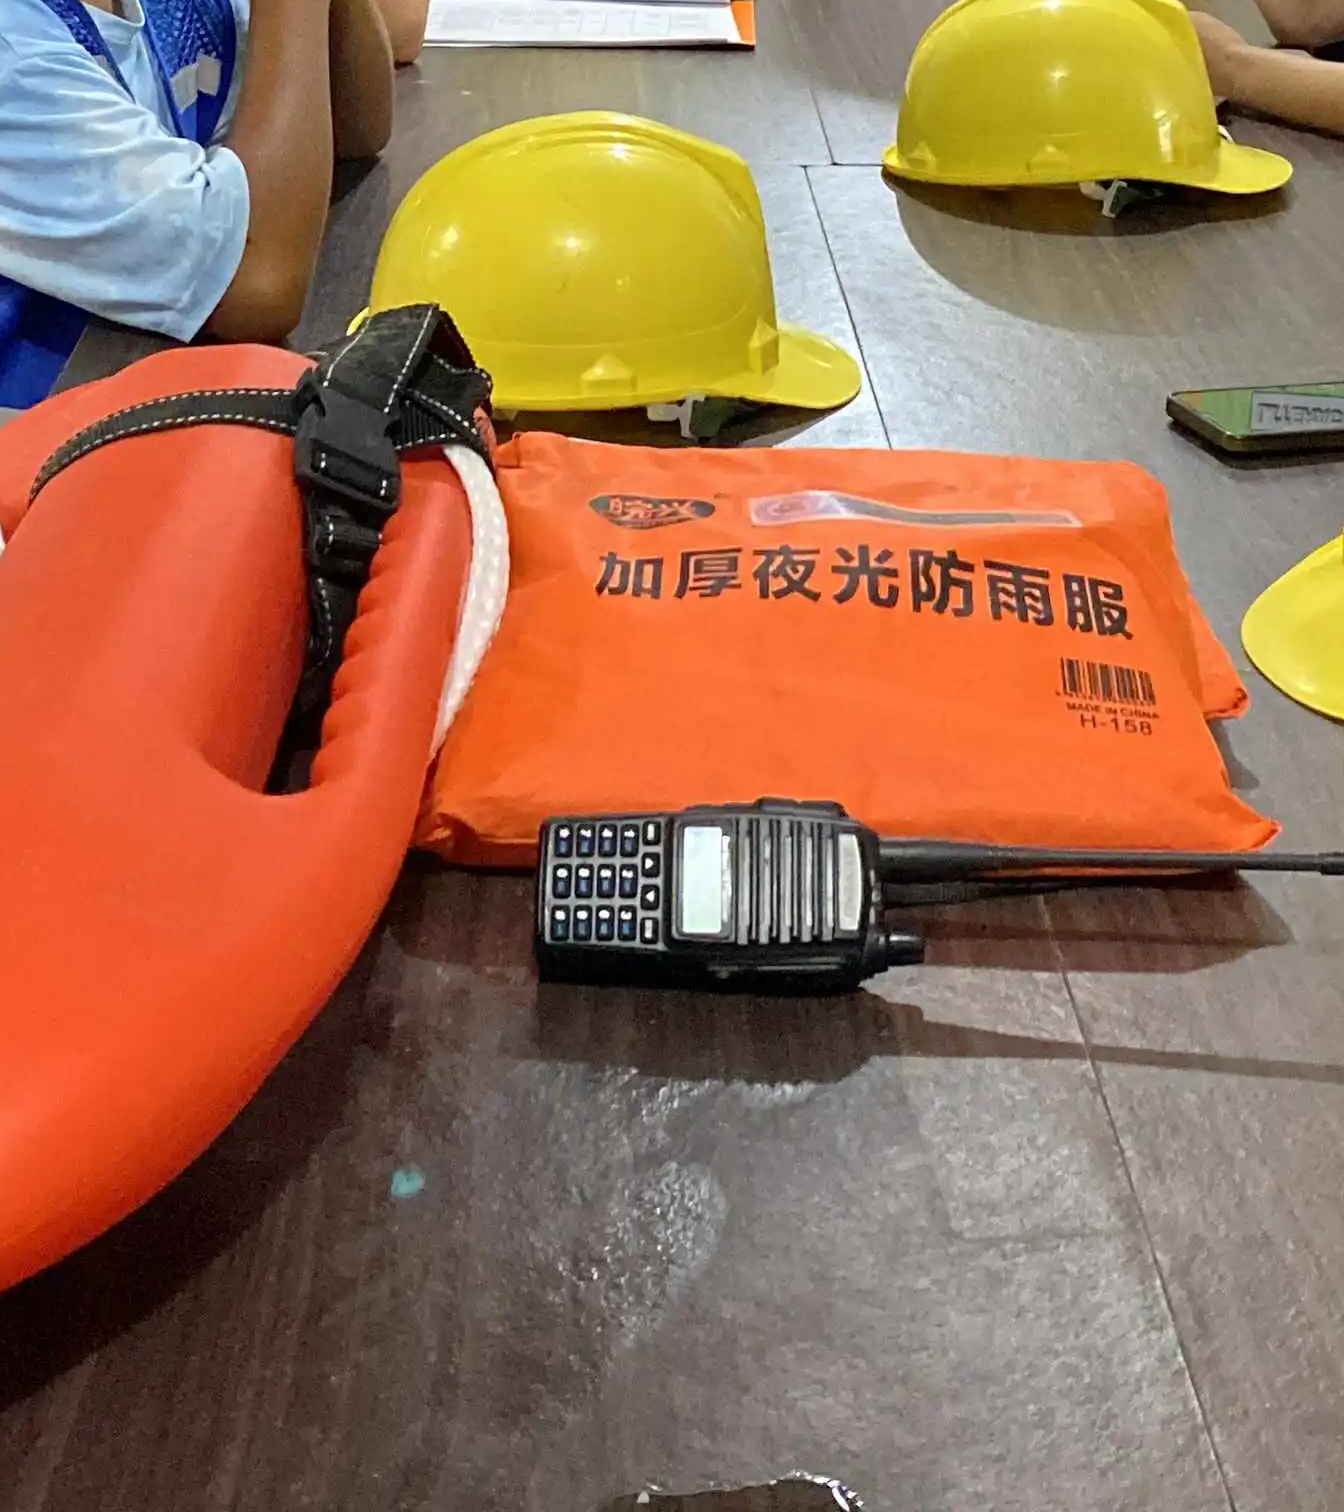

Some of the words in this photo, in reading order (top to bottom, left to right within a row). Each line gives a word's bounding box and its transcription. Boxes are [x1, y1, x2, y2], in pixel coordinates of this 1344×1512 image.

[595, 542, 1135, 641] 加厚夜光防雨服
[1080, 713, 1153, 736] H-158
